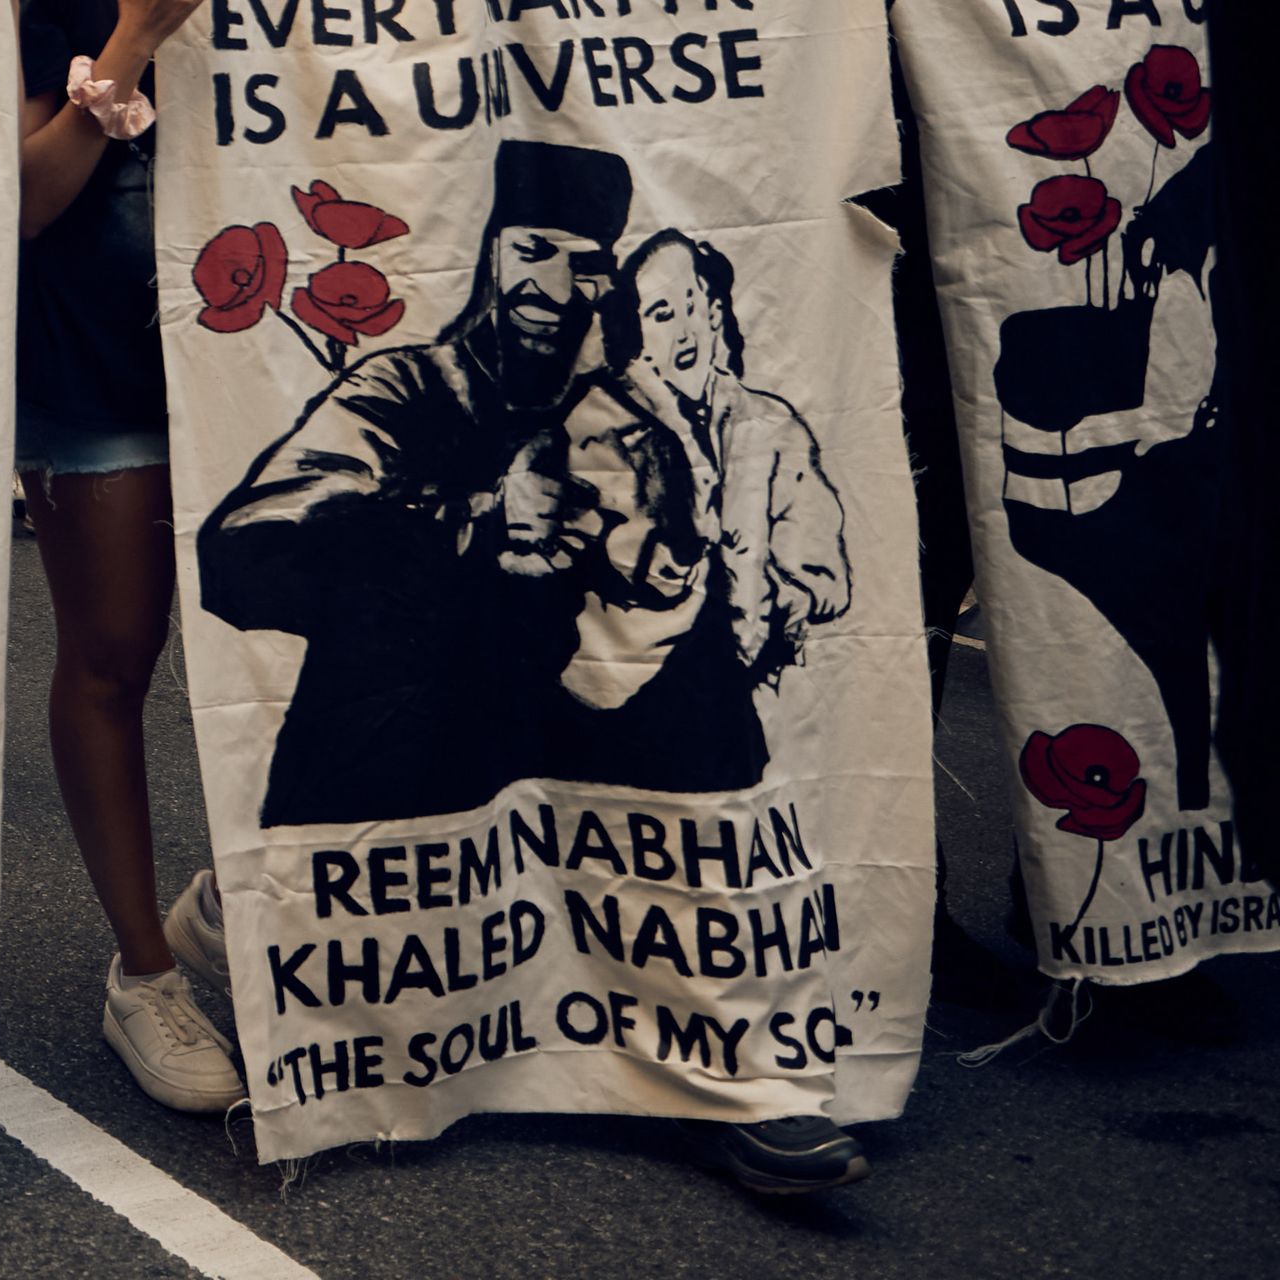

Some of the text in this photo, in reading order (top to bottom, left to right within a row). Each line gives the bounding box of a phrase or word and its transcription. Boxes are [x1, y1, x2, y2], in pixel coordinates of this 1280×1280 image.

[212, 71, 287, 146] IS
[313, 69, 390, 139] A
[311, 802, 813, 919] REEM NABHAN
[1138, 820, 1268, 903] HIN
[267, 898, 546, 1015] KHALED
[1049, 892, 1280, 967] KILLED BY ISRA
[403, 1000, 537, 1089] SOUL
[555, 990, 640, 1048] OF
[655, 1004, 751, 1077] MY
